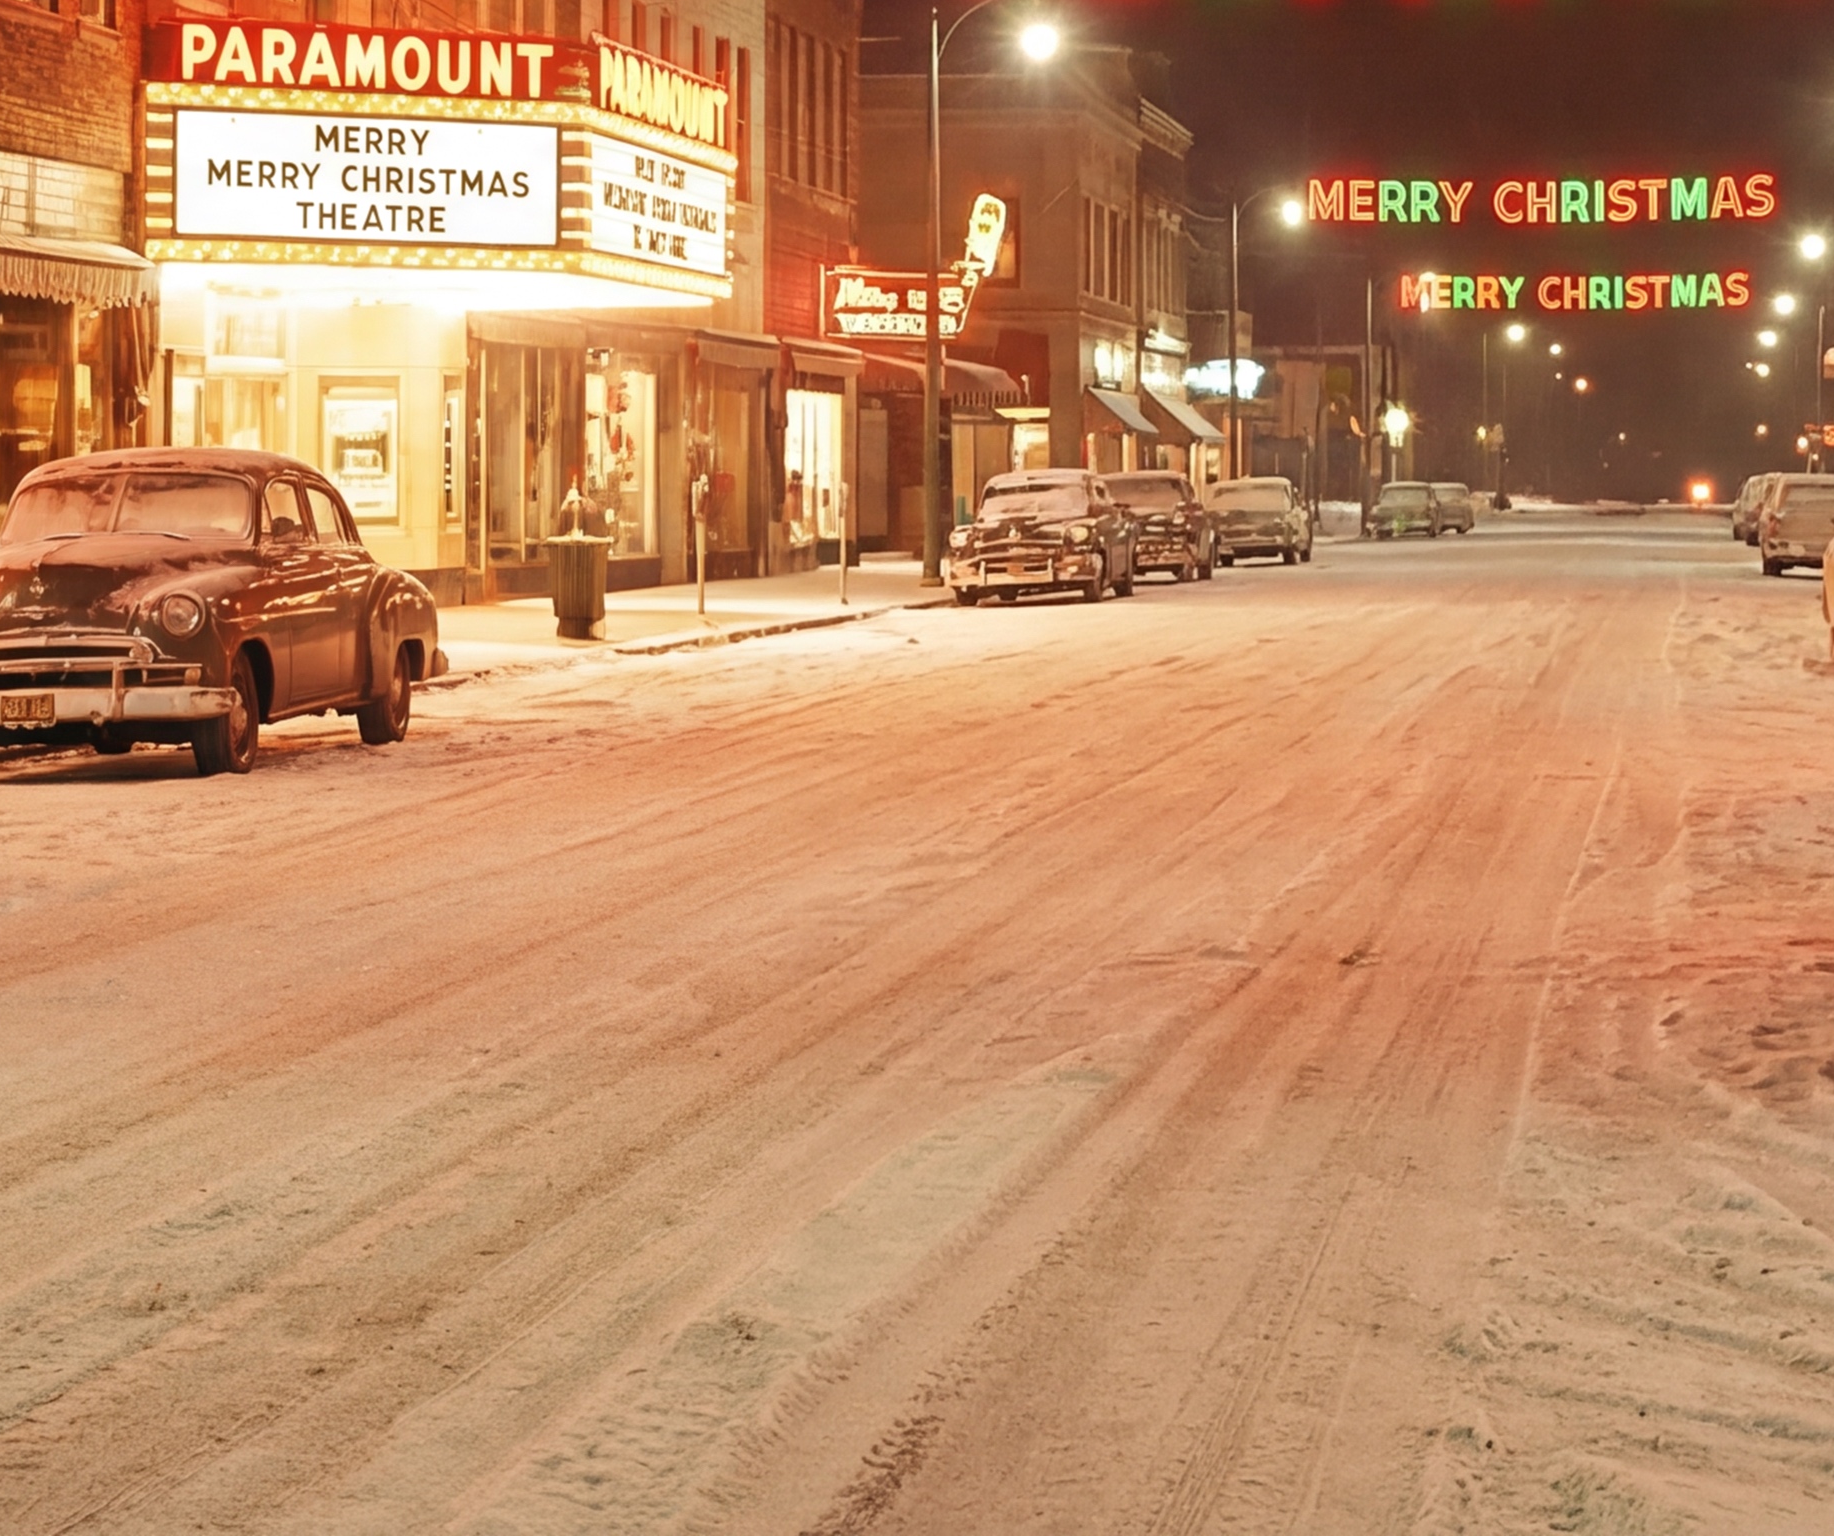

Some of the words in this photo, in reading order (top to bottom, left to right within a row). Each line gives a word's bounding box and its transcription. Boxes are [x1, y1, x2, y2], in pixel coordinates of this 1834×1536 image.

[181, 23, 555, 98] PARAMOUNT
[599, 45, 728, 148] PARAMOUNT
[314, 124, 430, 156] MERRY
[207, 158, 321, 190] MERRY
[341, 164, 531, 199] CHRISTMAS
[1307, 178, 1473, 223] MERRY
[1493, 173, 1777, 224] CHRISTMAS
[296, 201, 446, 233] THEATRE
[1400, 274, 1525, 310] MERRY
[1538, 271, 1751, 311] CHRISTMAS
